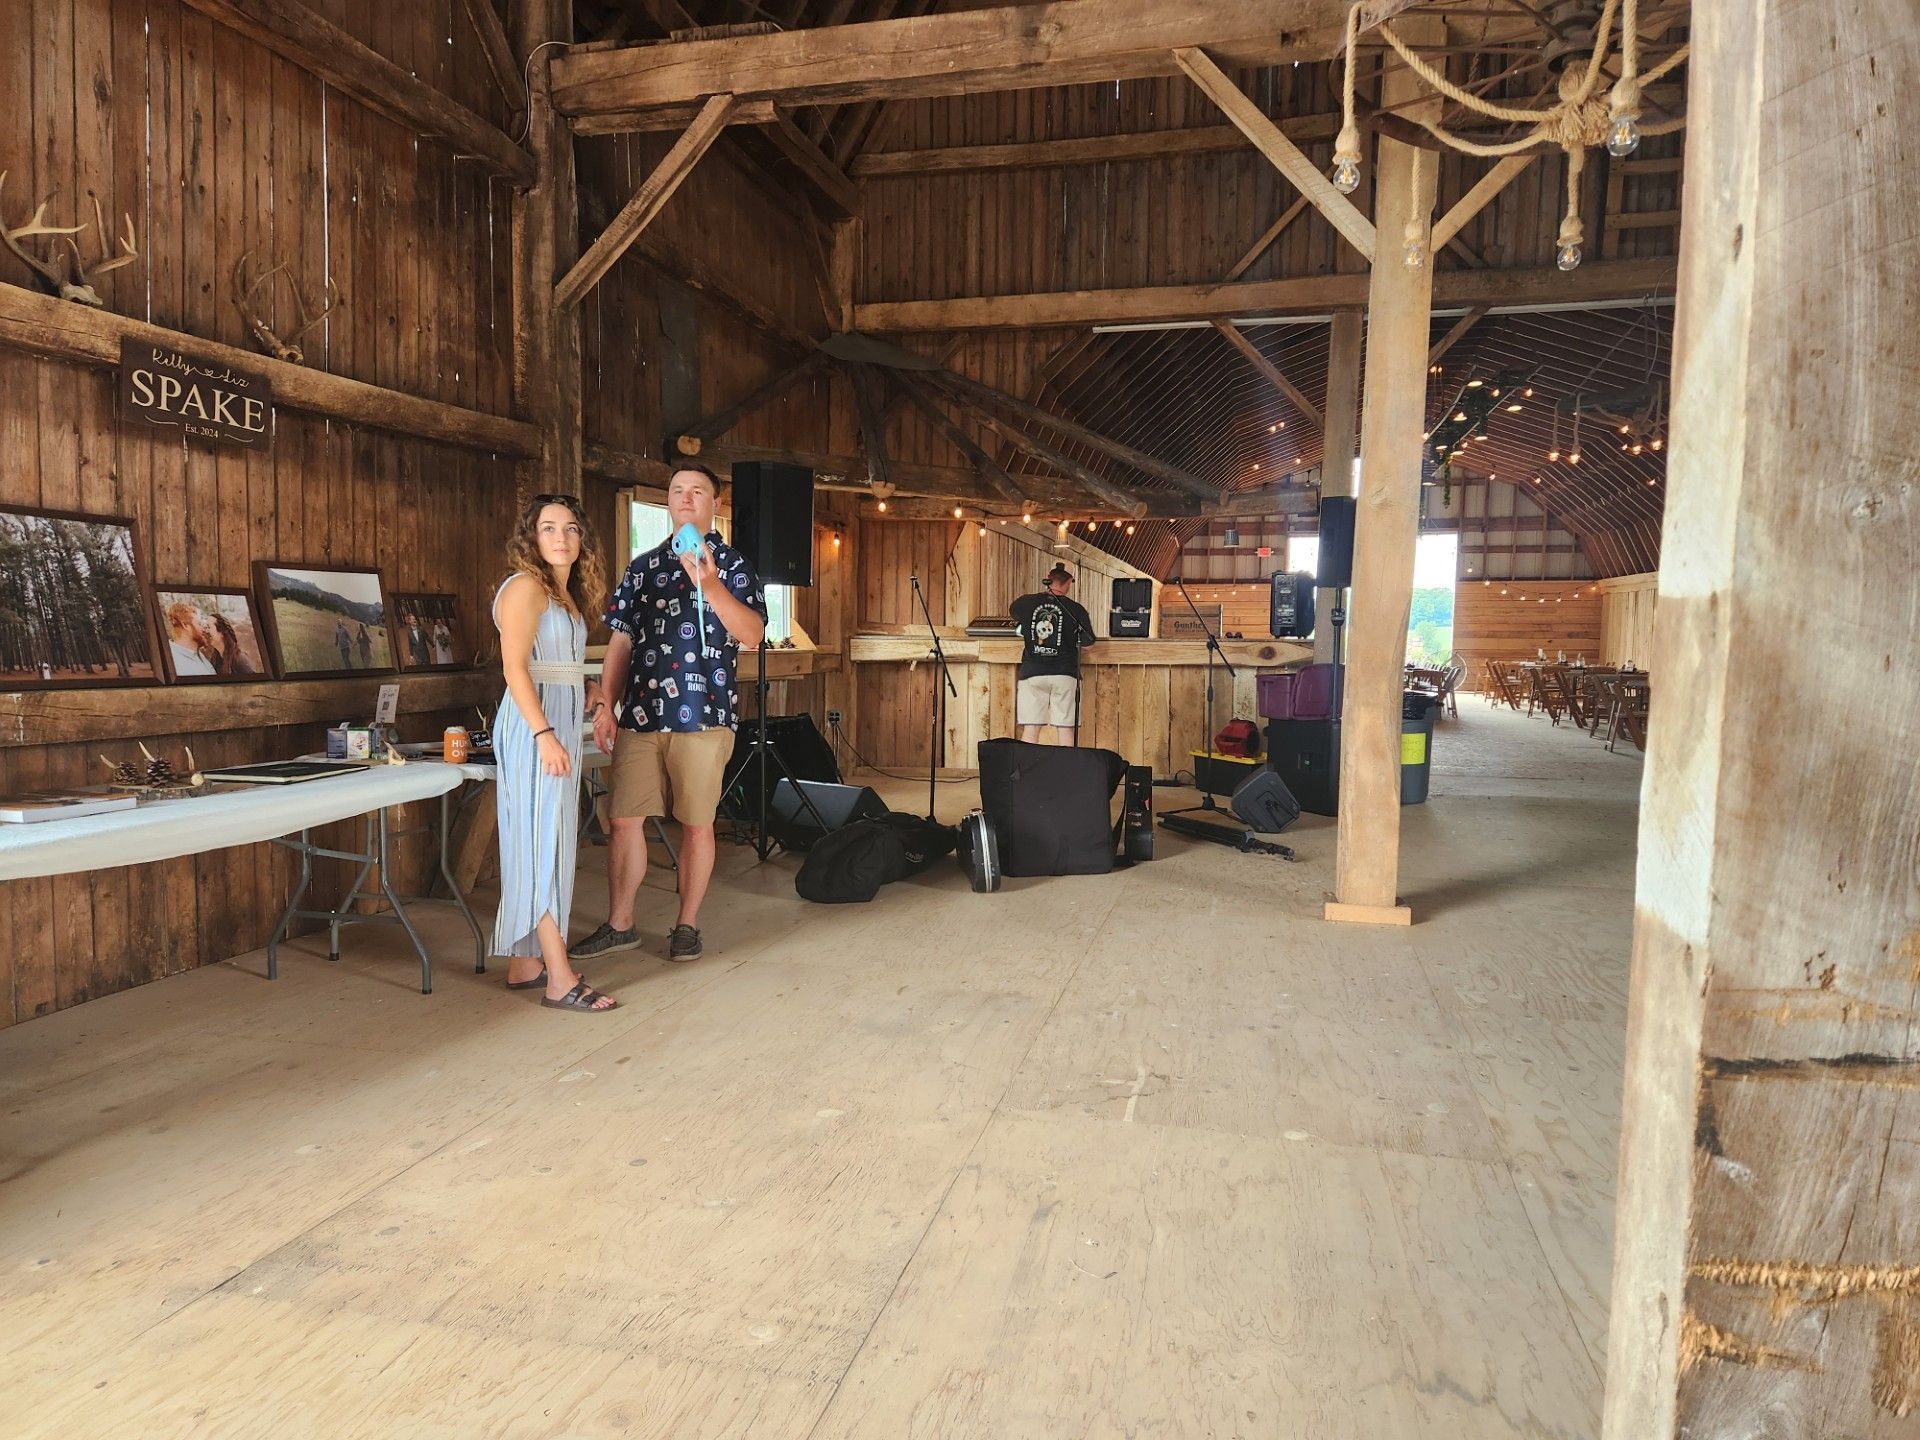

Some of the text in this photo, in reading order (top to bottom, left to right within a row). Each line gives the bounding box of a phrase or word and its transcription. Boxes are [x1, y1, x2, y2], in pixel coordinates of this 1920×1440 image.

[221, 368, 250, 388] Liz
[131, 369, 265, 433] SPAKE
[200, 426, 219, 438] 2024
